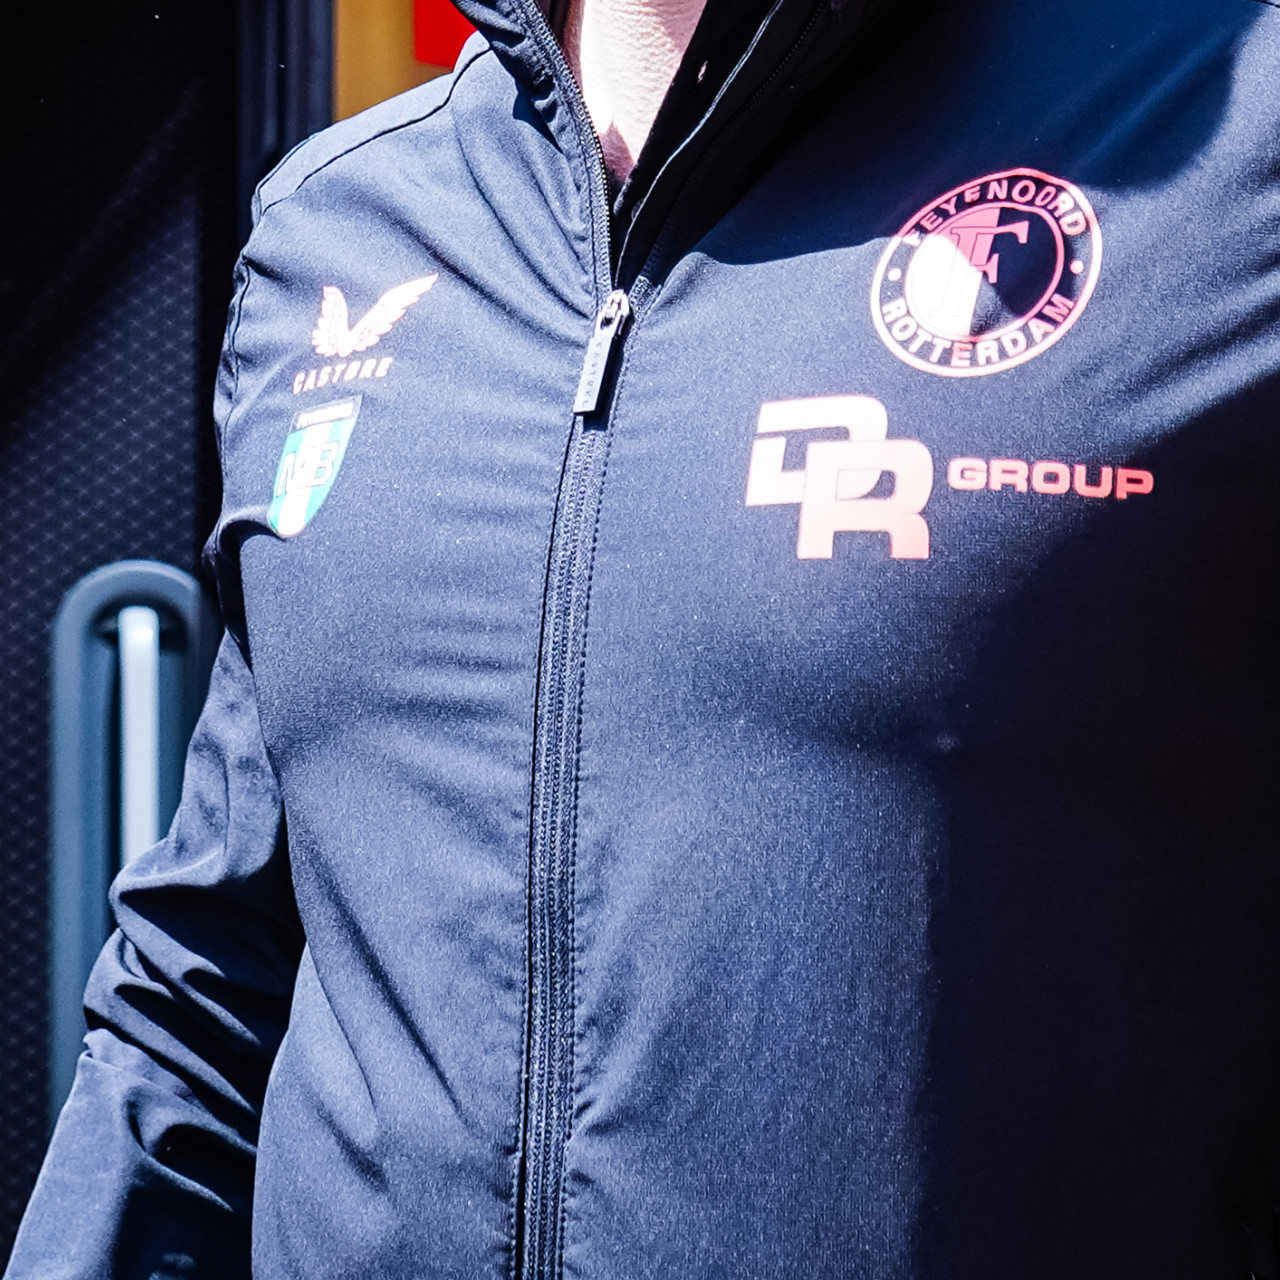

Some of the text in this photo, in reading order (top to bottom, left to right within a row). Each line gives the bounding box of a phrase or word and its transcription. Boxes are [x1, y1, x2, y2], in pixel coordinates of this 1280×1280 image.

[902, 180, 1087, 246] FEYENOORD
[882, 293, 1075, 367] ROTTERDAM
[292, 357, 394, 395] CASTORE
[947, 457, 1155, 500] GROUP
